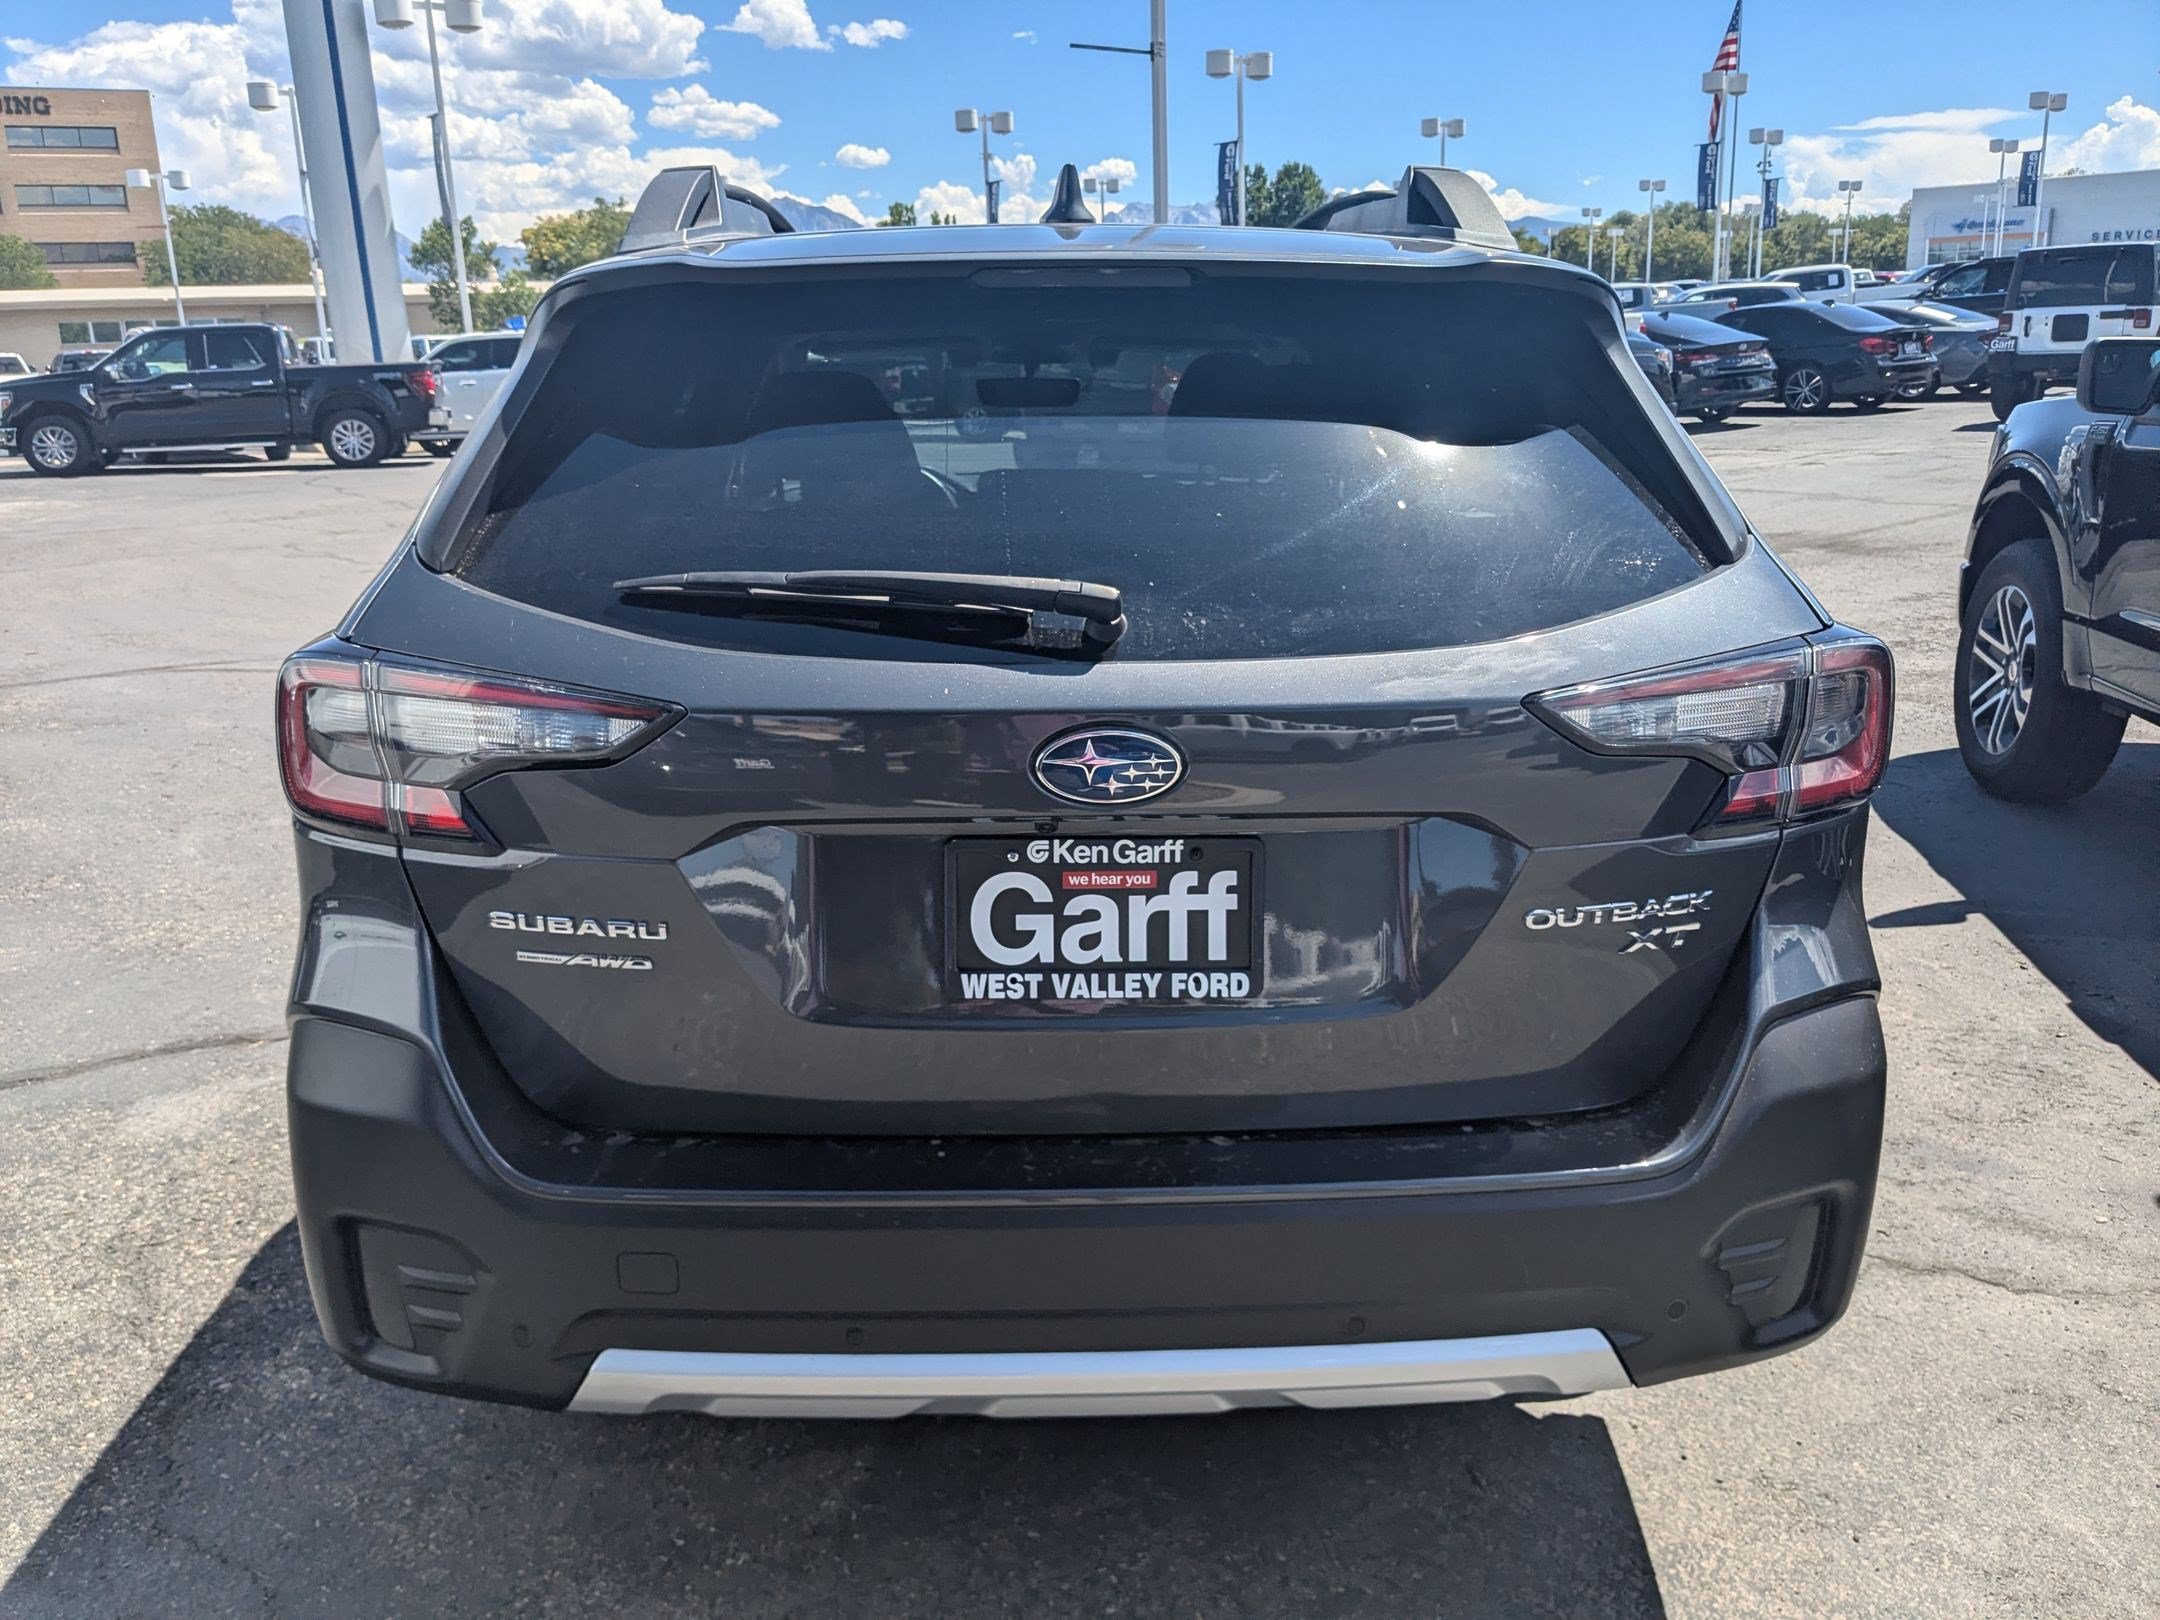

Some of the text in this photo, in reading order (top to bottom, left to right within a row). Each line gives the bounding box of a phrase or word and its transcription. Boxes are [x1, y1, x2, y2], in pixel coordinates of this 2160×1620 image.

[0, 95, 51, 116] ING
[1053, 839, 1185, 864] Ken Garff
[1068, 872, 1151, 888] we hear you
[970, 870, 1239, 966] Garff
[1524, 889, 1713, 930] OUTBACK
[489, 911, 668, 940] SUBARU
[1618, 922, 1701, 954] XT
[566, 953, 653, 970] AWD
[960, 972, 1250, 999] WEST VALLEY FORD
